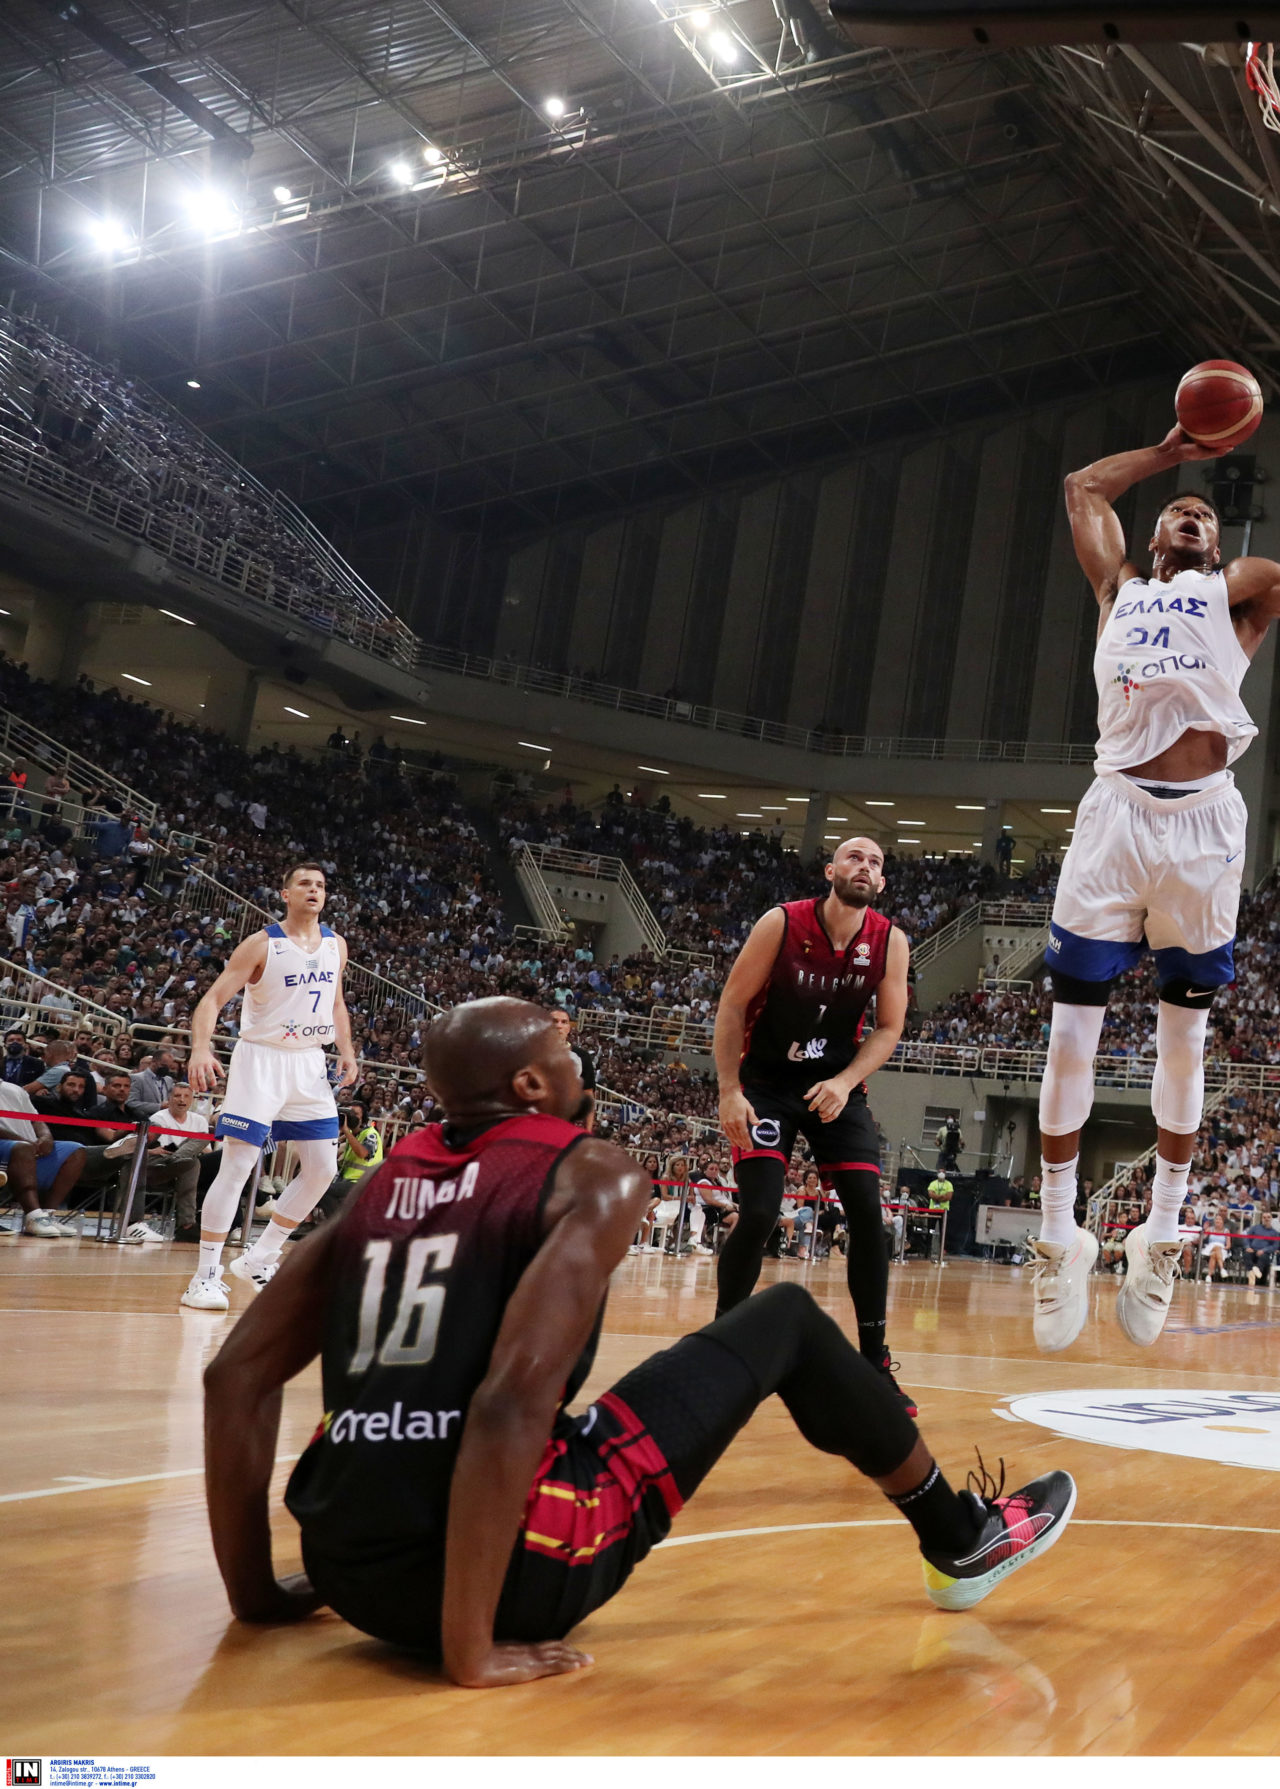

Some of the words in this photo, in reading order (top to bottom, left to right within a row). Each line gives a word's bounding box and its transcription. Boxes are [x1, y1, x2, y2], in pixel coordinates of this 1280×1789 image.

[1114, 597, 1208, 620] ΕΛΛΑΣ
[284, 971, 335, 987] ΕΛΛΑΣ
[309, 991, 321, 1013] 7
[347, 1233, 460, 1375] 16
